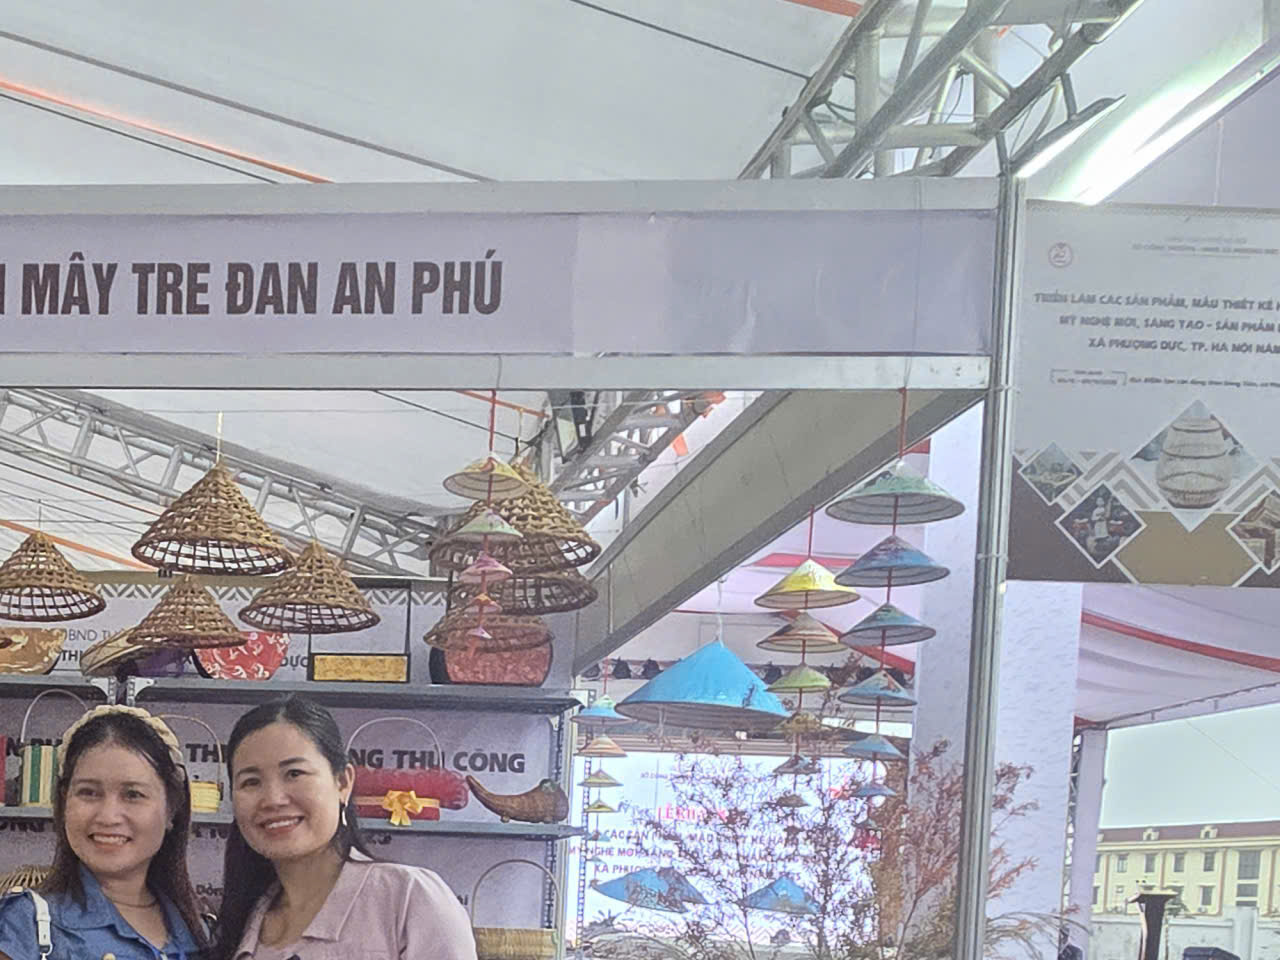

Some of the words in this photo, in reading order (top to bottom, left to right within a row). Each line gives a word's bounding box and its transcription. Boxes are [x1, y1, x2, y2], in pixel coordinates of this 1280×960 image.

[21, 251, 118, 315] MÂY
[131, 262, 211, 315] TRE
[225, 262, 318, 315] ĐAN
[331, 261, 396, 315] AN
[411, 249, 502, 315] PHÚ
[452, 748, 526, 773] CÔNG
